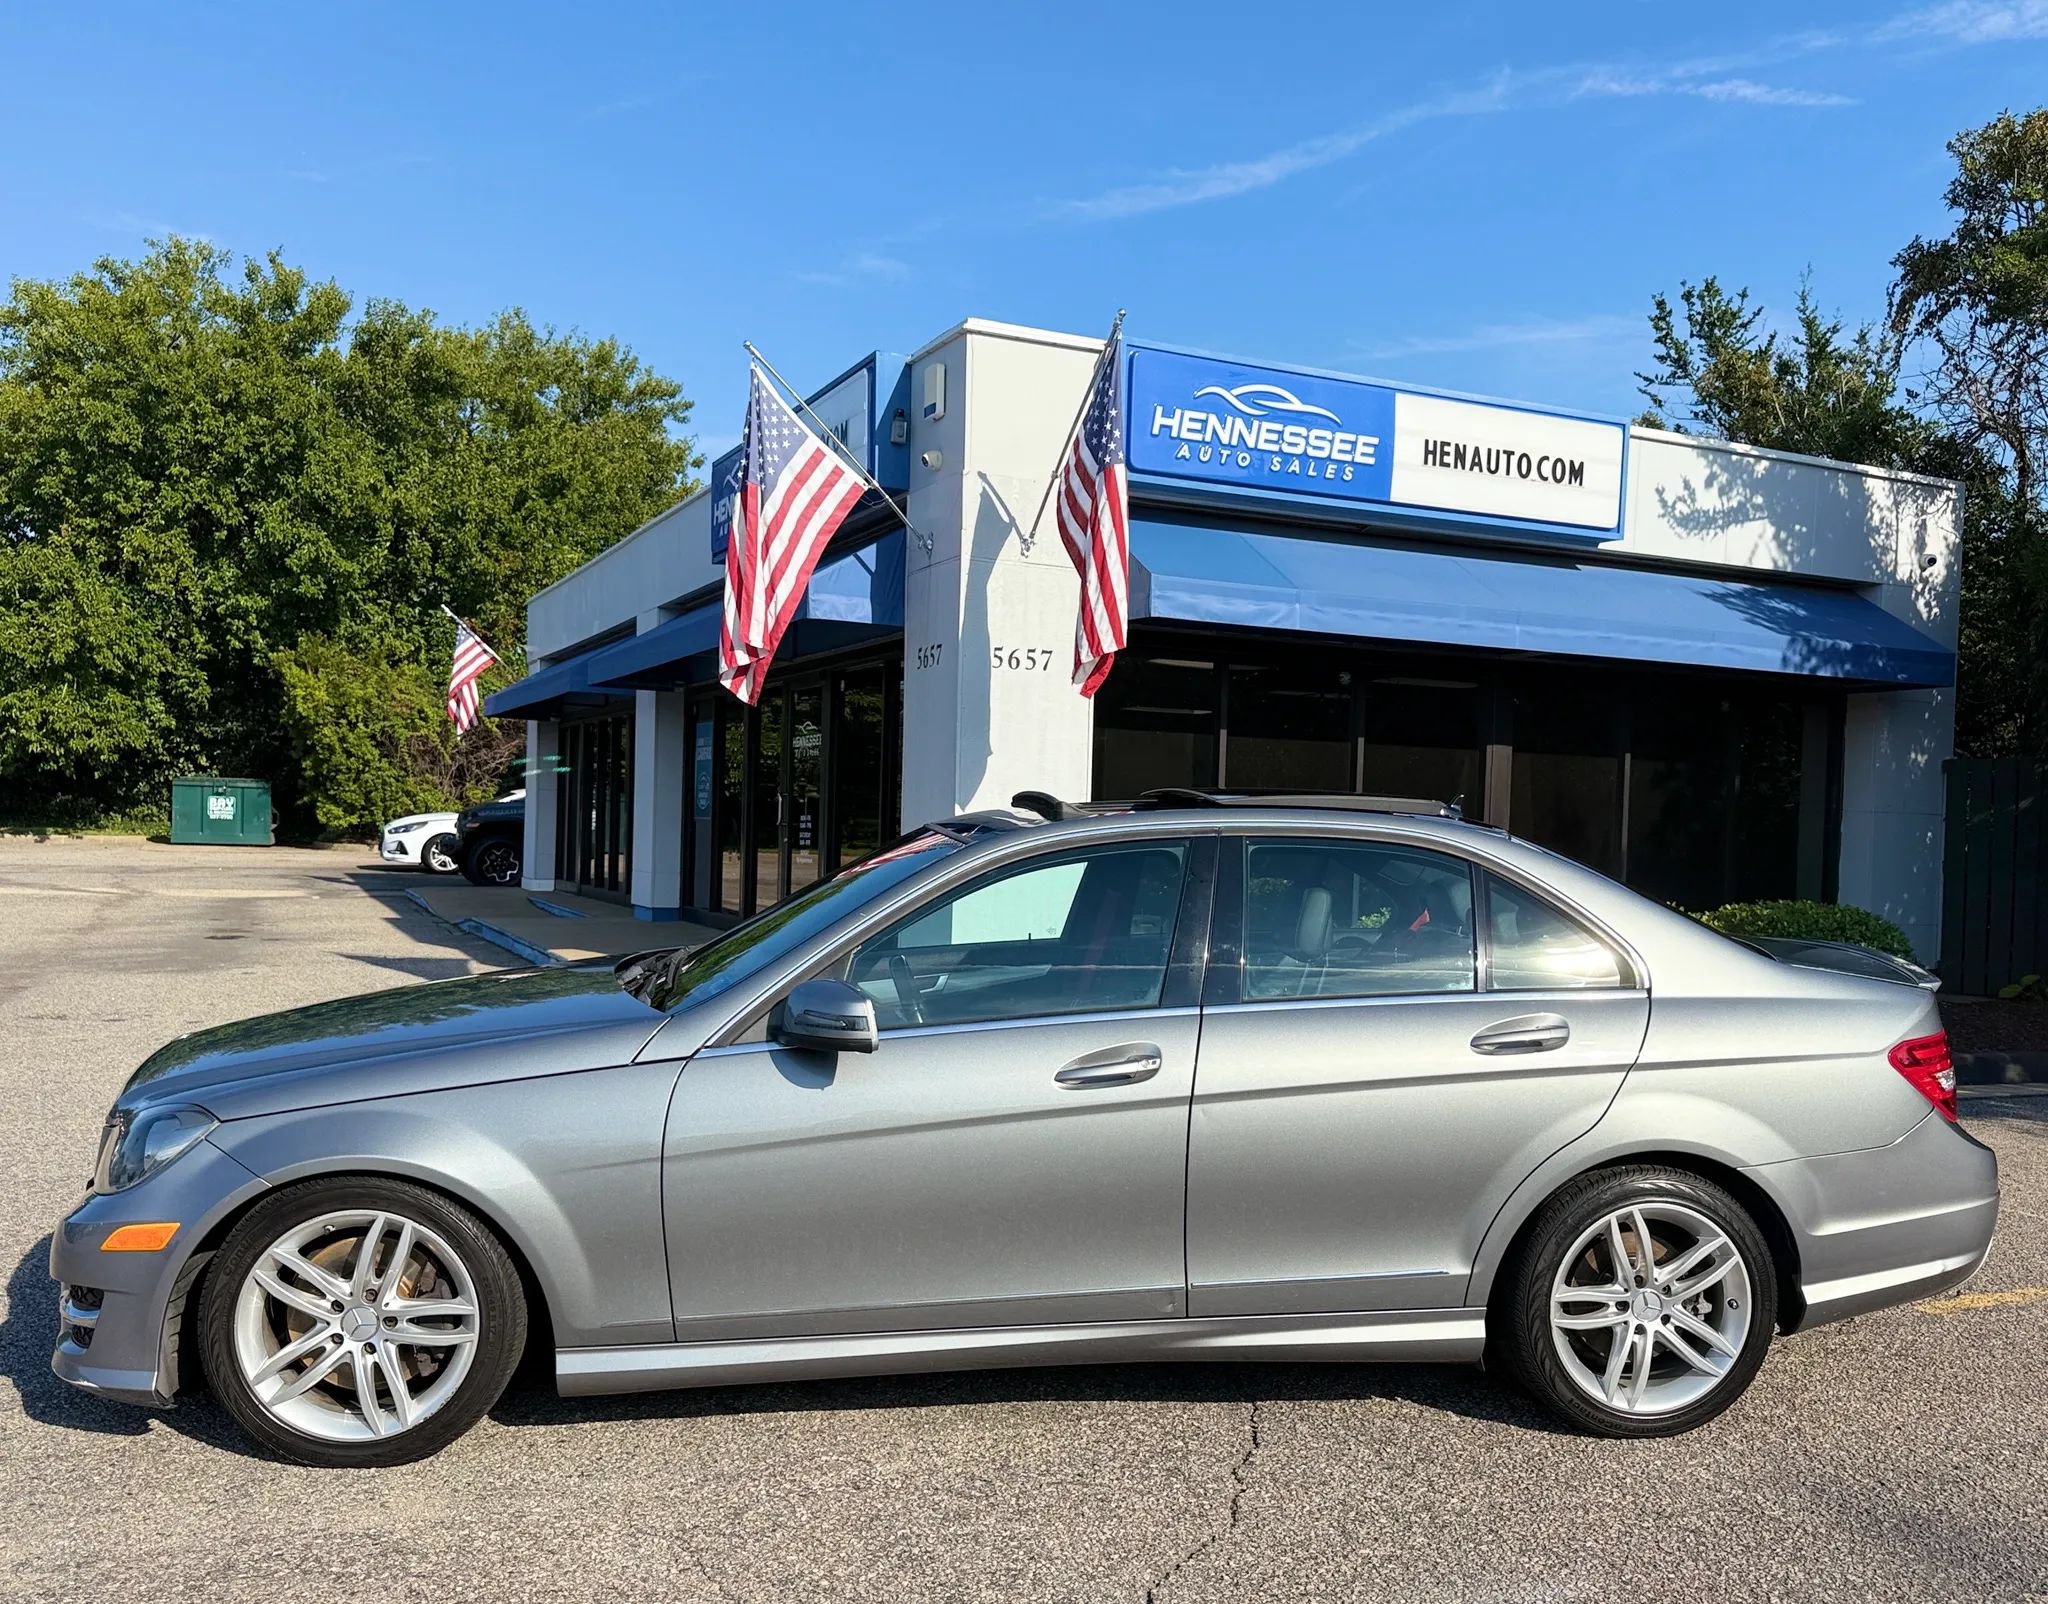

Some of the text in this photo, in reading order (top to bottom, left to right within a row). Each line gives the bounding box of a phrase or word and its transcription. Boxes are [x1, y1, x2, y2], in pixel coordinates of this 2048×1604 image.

[1151, 404, 1380, 465] HENNESSEE
[1176, 443, 1354, 481] AUTO SALES
[917, 643, 942, 670] 5657
[992, 645, 1053, 671] 5657
